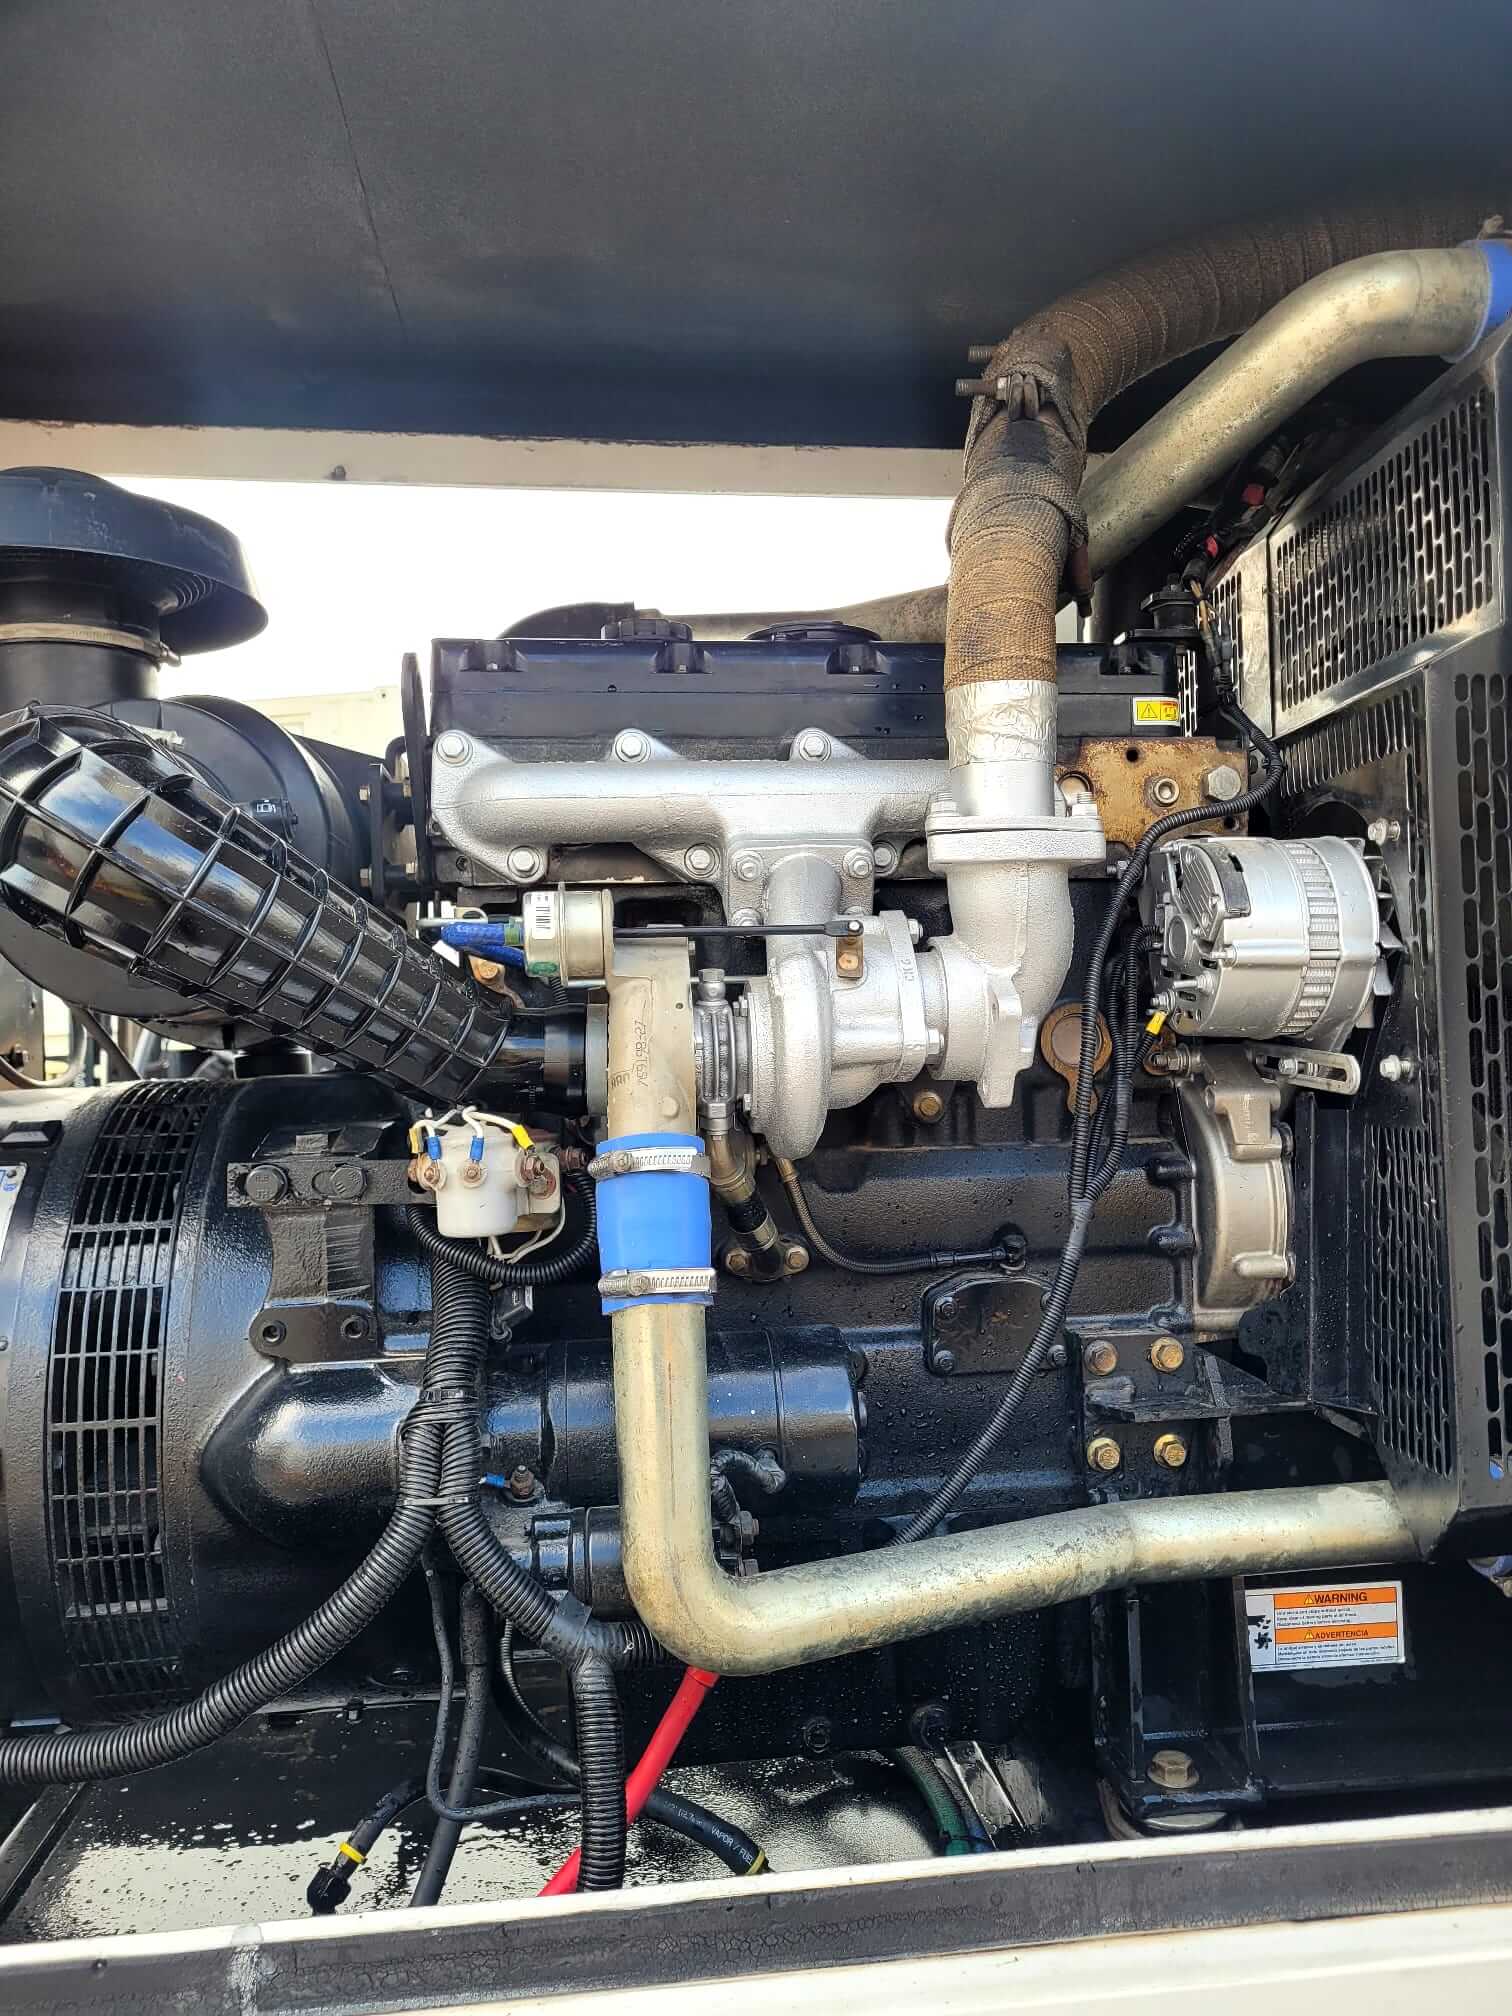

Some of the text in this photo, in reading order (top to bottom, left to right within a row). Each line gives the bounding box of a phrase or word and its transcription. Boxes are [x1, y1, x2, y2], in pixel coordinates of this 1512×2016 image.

[1315, 1592, 1367, 1604] WARNING
[1315, 1630, 1368, 1639] ADVERTENCIA
[711, 1826, 734, 1847] VAPOR
[739, 1847, 753, 1865] FUEL
